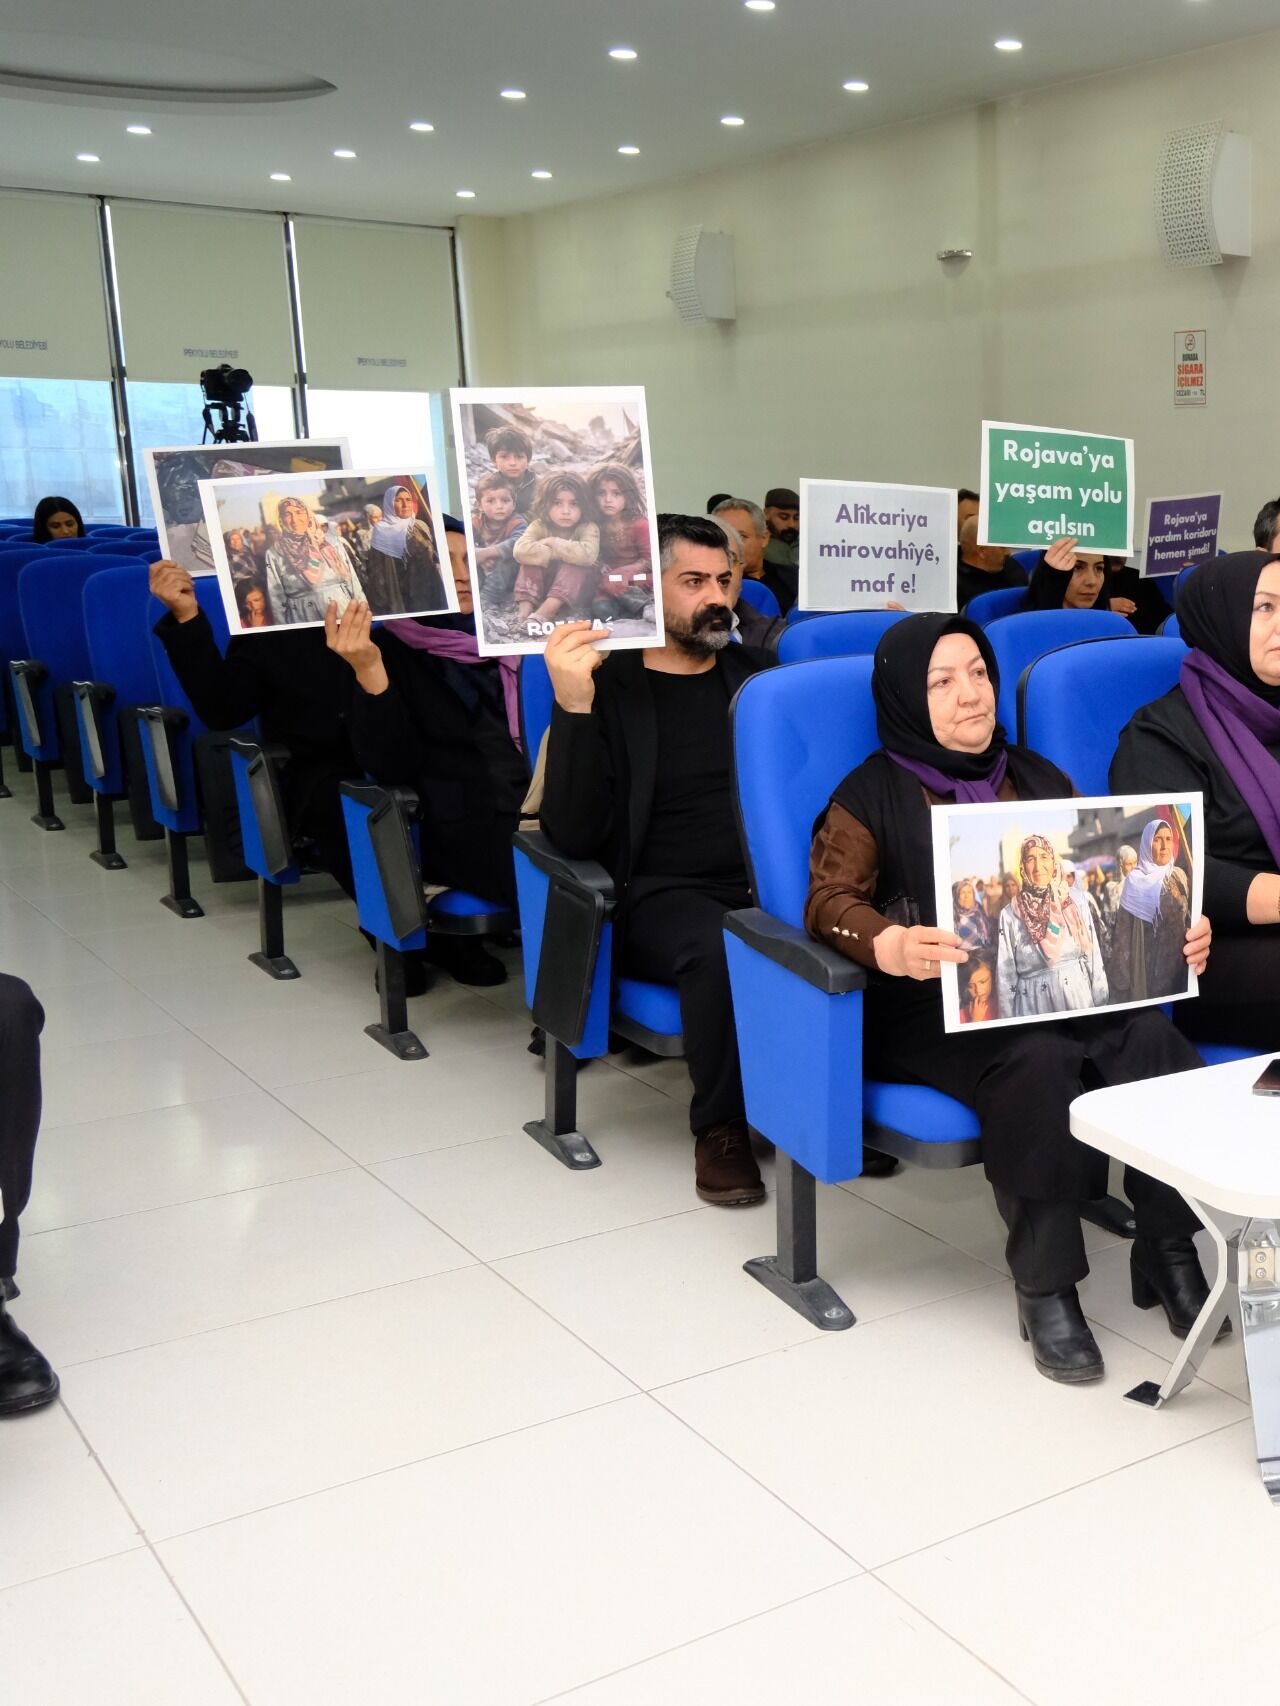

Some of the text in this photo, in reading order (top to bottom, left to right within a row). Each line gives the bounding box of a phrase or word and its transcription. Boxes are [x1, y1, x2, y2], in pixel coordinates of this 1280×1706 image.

[1177, 363, 1203, 375] SİGARA
[1177, 376, 1204, 389] İÇİLMEZ
[994, 481, 1123, 508] yaşam yolu
[835, 503, 928, 533] Alîkariya
[1027, 513, 1096, 541] açılsın
[1149, 526, 1217, 547] yardım koridoru
[819, 538, 940, 566] mirovahîyê,
[1154, 542, 1210, 560] hemen şimdi!
[851, 572, 917, 594] maf e!
[527, 618, 604, 636] ROA
